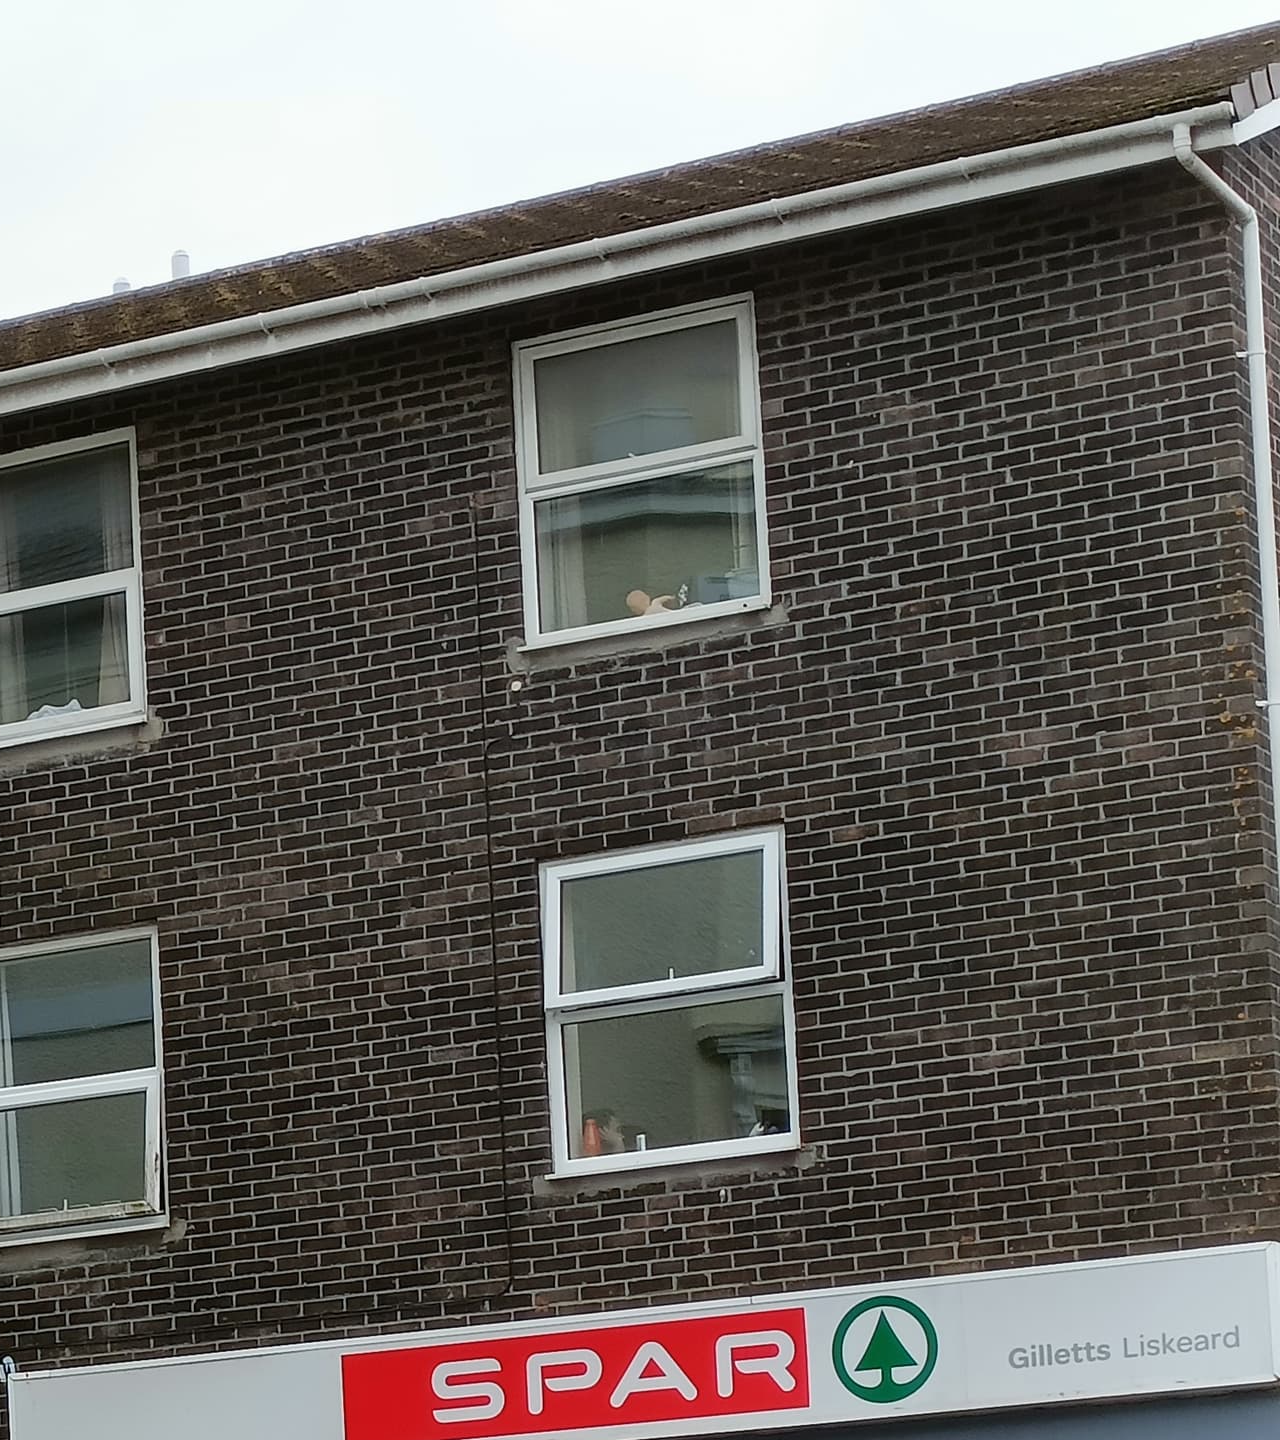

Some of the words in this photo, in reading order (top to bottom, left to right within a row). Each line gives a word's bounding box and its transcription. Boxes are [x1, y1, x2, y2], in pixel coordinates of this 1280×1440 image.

[432, 1326, 796, 1424] SPAR
[1007, 1337, 1112, 1371] Gilletts
[1121, 1325, 1241, 1362] Liskeard
